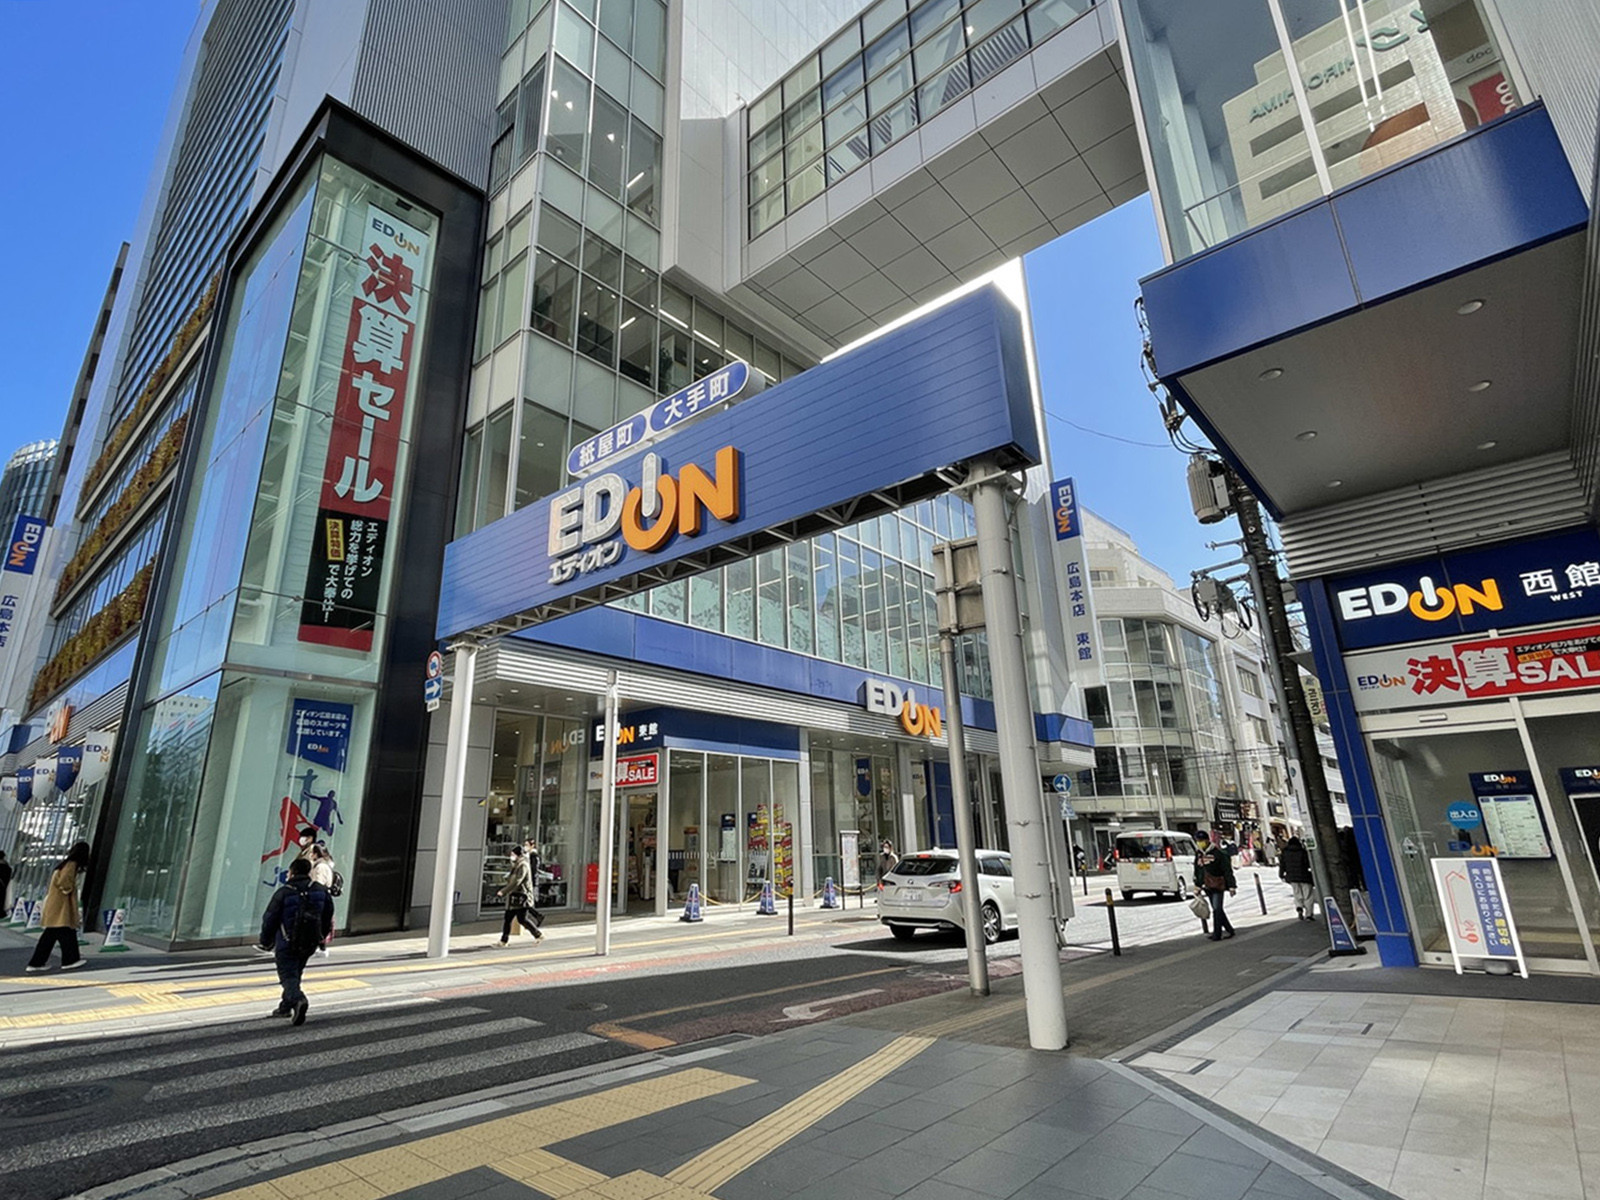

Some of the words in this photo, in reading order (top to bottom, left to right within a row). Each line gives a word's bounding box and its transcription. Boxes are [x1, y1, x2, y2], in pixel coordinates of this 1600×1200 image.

[372, 217, 421, 256] EDION
[334, 243, 414, 502] 決算セール
[578, 422, 634, 468] 紙屋町
[664, 371, 730, 425] 大手町
[547, 445, 738, 557] EDION
[1055, 484, 1074, 534] EDION
[9, 522, 42, 567] EDION
[360, 521, 378, 577] エディオン
[547, 540, 620, 584] エディオン
[1337, 576, 1504, 622] EDION
[1519, 561, 1600, 597] 西館
[1550, 590, 1583, 602] WEST
[1066, 562, 1086, 617] 広島本店
[1076, 632, 1092, 661] 東館
[1357, 674, 1407, 688] EDION
[1407, 647, 1517, 696] 決算
[863, 679, 942, 737] EDION
[628, 767, 655, 782] SALE
